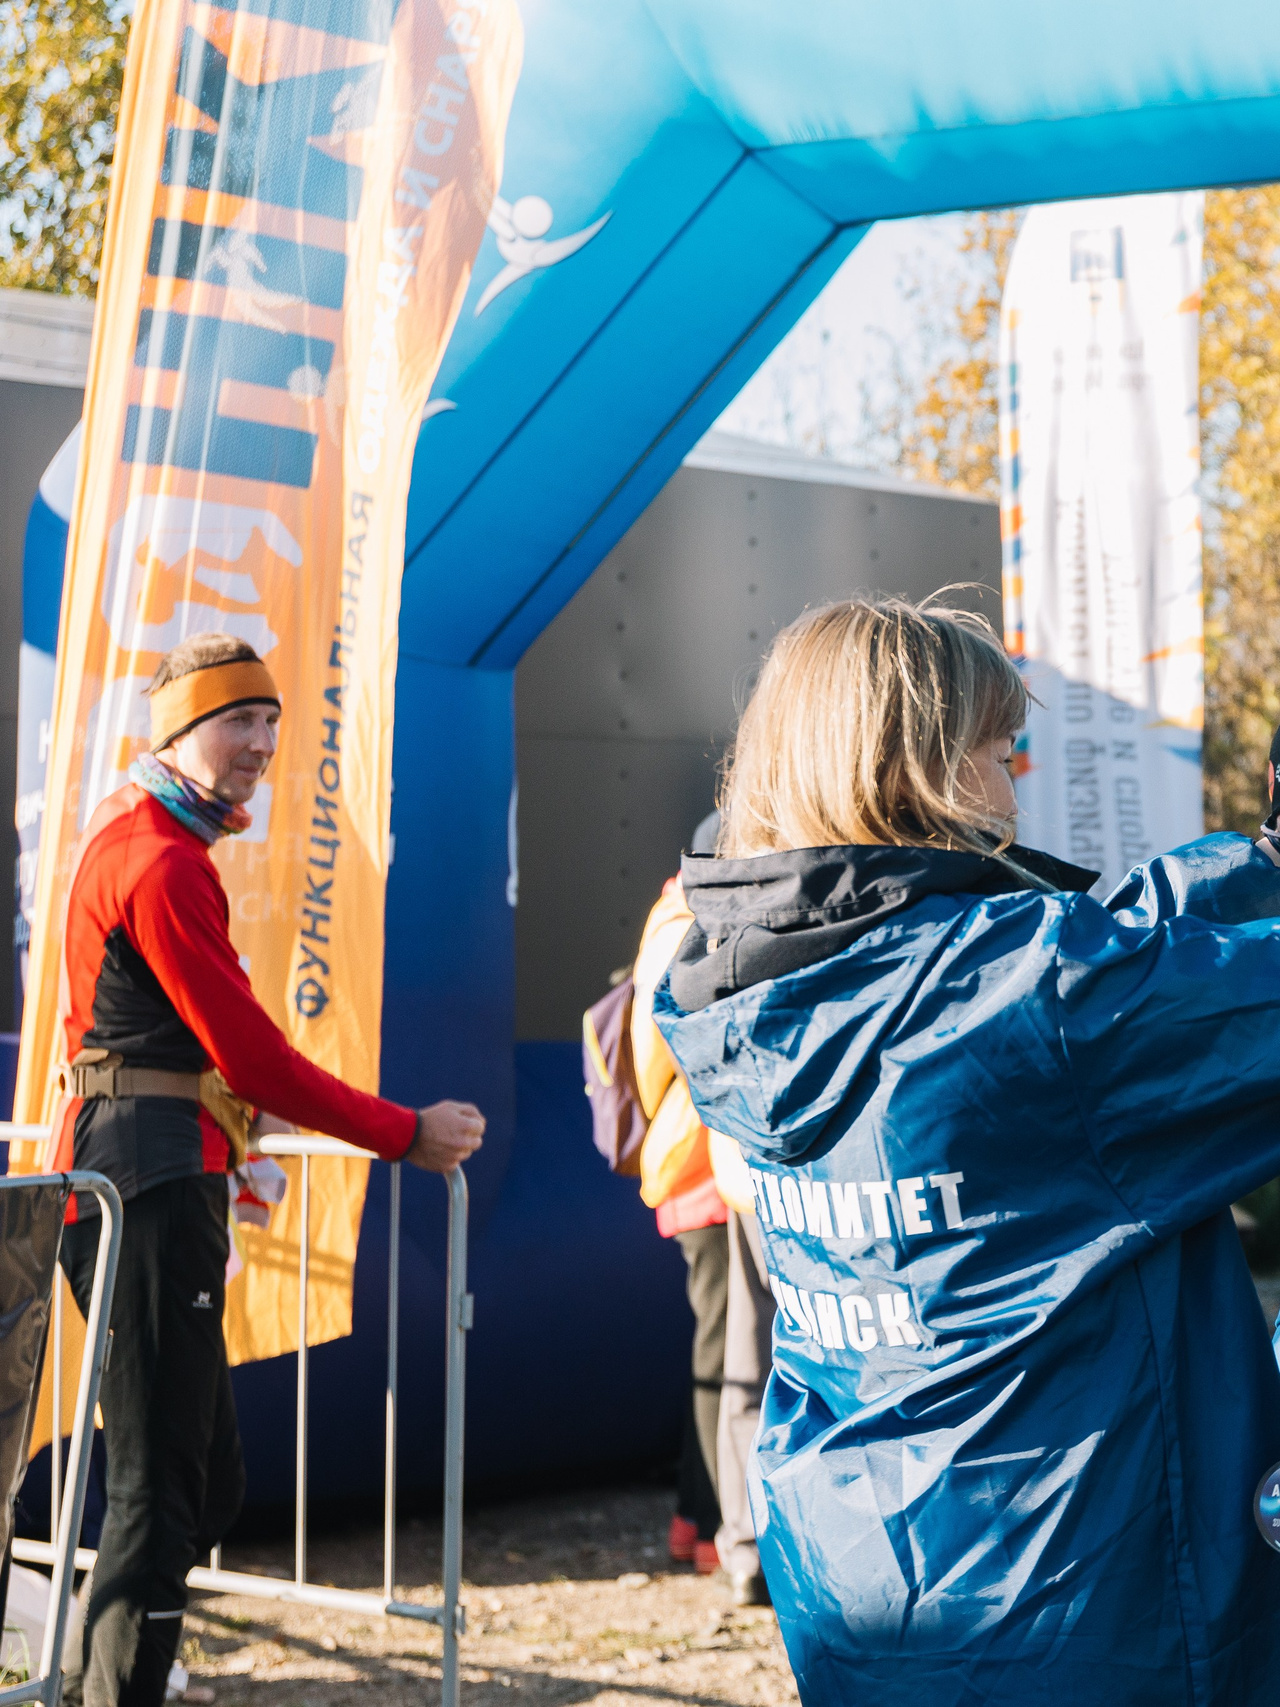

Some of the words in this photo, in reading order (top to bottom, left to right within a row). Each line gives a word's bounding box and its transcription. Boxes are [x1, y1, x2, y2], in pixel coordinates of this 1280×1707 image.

[295, 491, 373, 1019] ФУНКЦИОНАЛЬНАЯ
[357, 226, 423, 474] ОДЕЖДА
[394, 166, 439, 211] И
